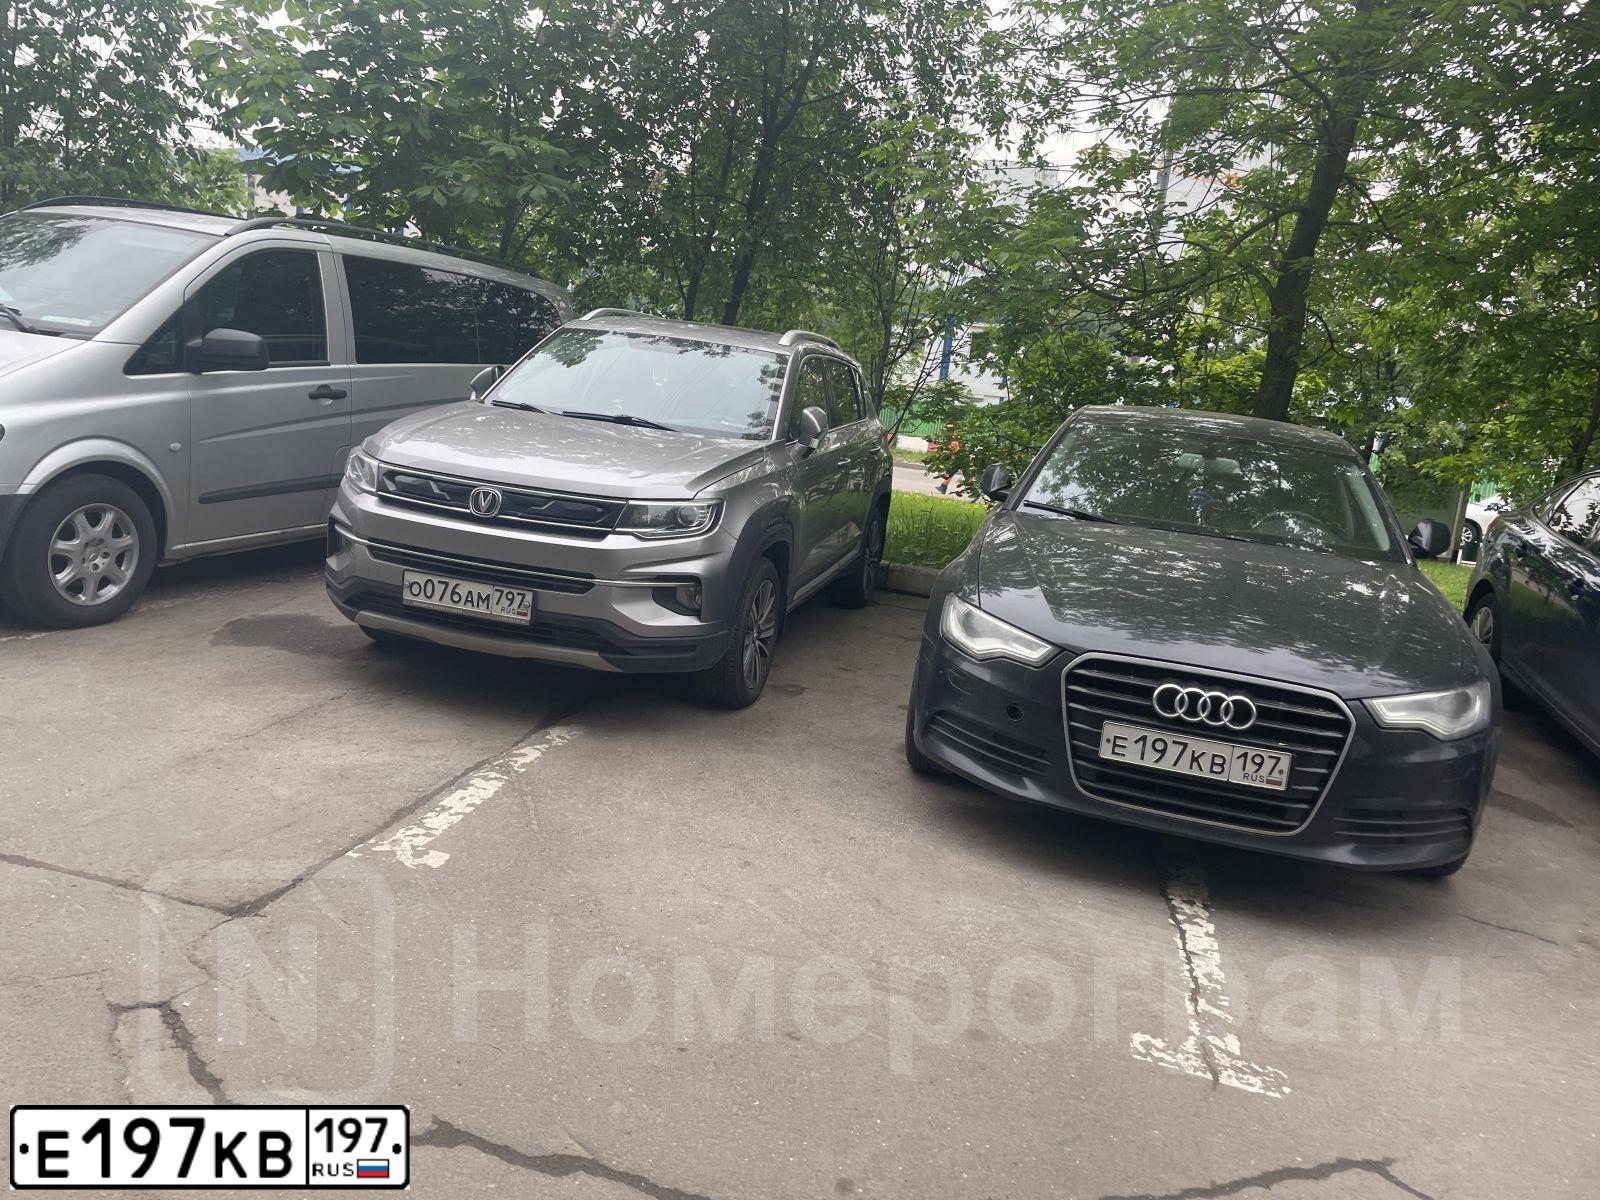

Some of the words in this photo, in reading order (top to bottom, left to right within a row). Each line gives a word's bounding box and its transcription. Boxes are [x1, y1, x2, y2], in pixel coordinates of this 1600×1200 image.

[494, 588, 527, 609] 797
[500, 606, 516, 615] RUS
[1236, 751, 1282, 776] 197
[1242, 772, 1265, 783] RUS
